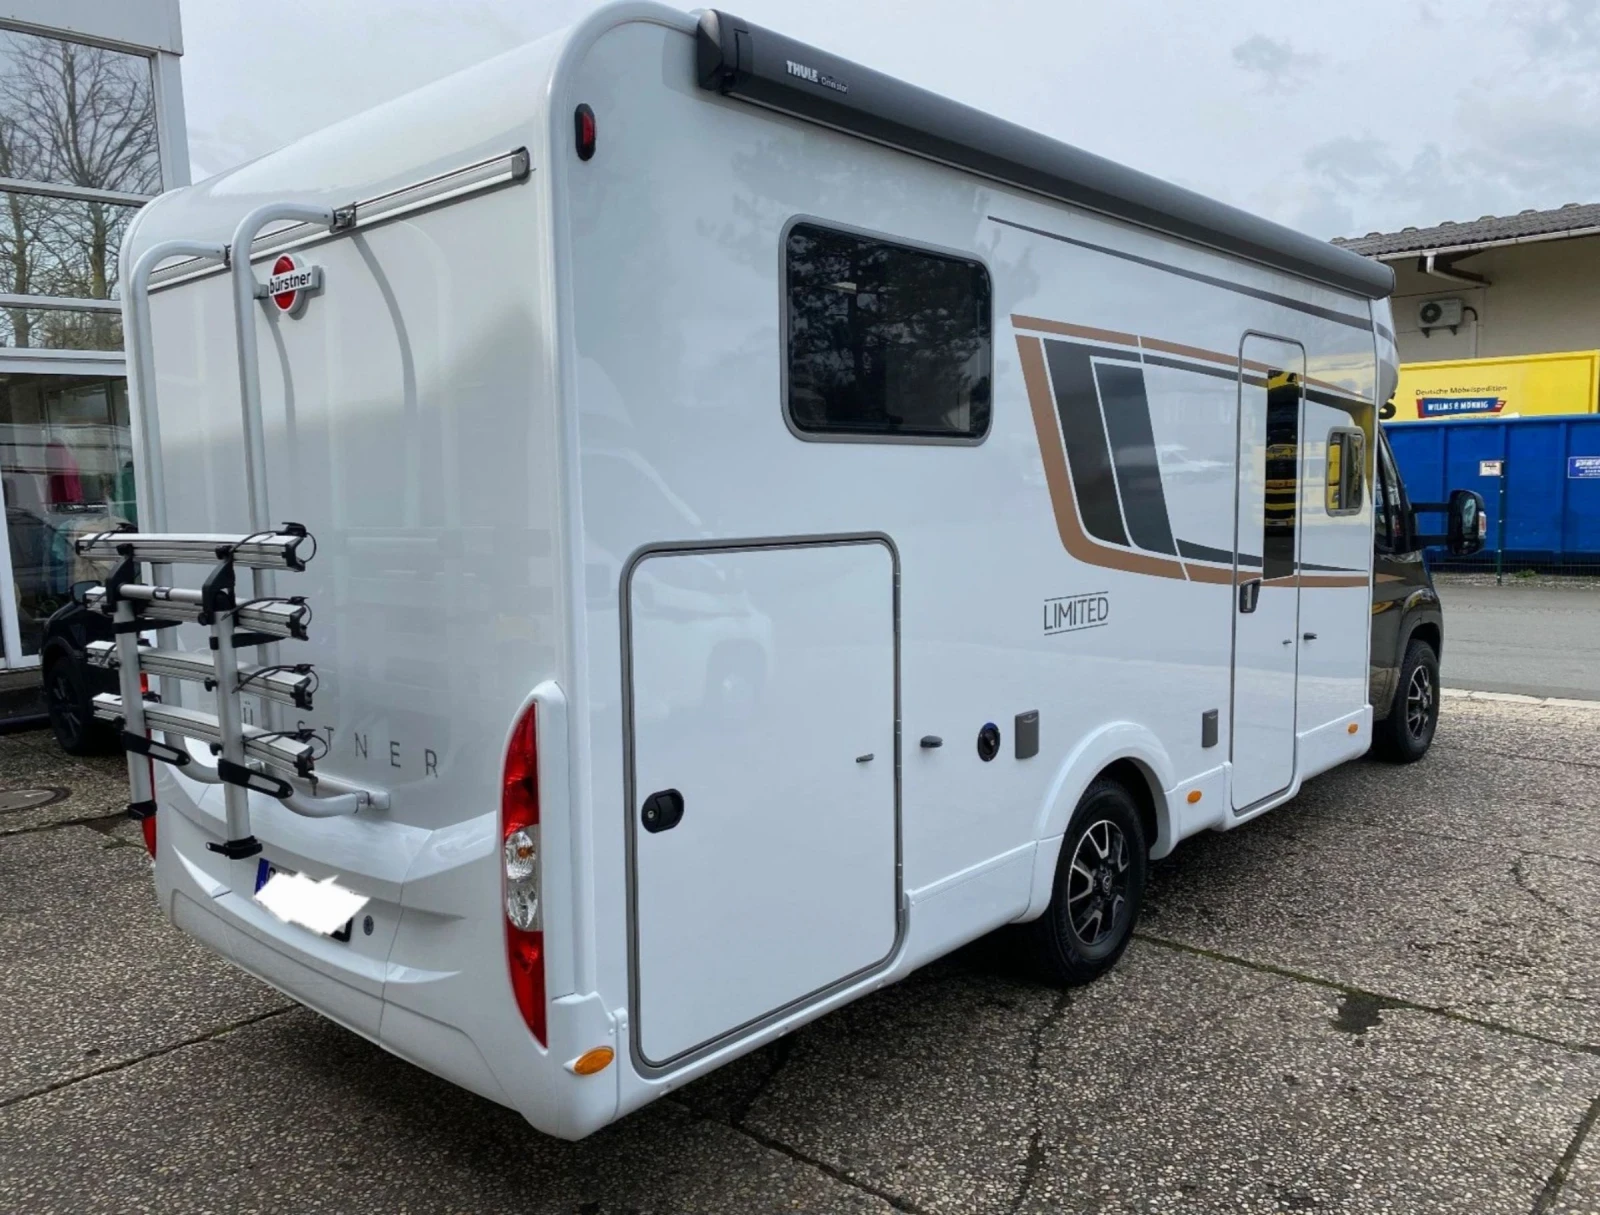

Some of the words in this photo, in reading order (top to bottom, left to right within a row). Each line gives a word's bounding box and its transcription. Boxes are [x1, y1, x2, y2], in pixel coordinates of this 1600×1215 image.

[786, 60, 819, 83] THULE
[269, 272, 312, 295] bürstner
[1415, 388, 1449, 396] Deutsche
[1427, 402, 1453, 411] WILLMS
[1044, 597, 1109, 630] LIMITED
